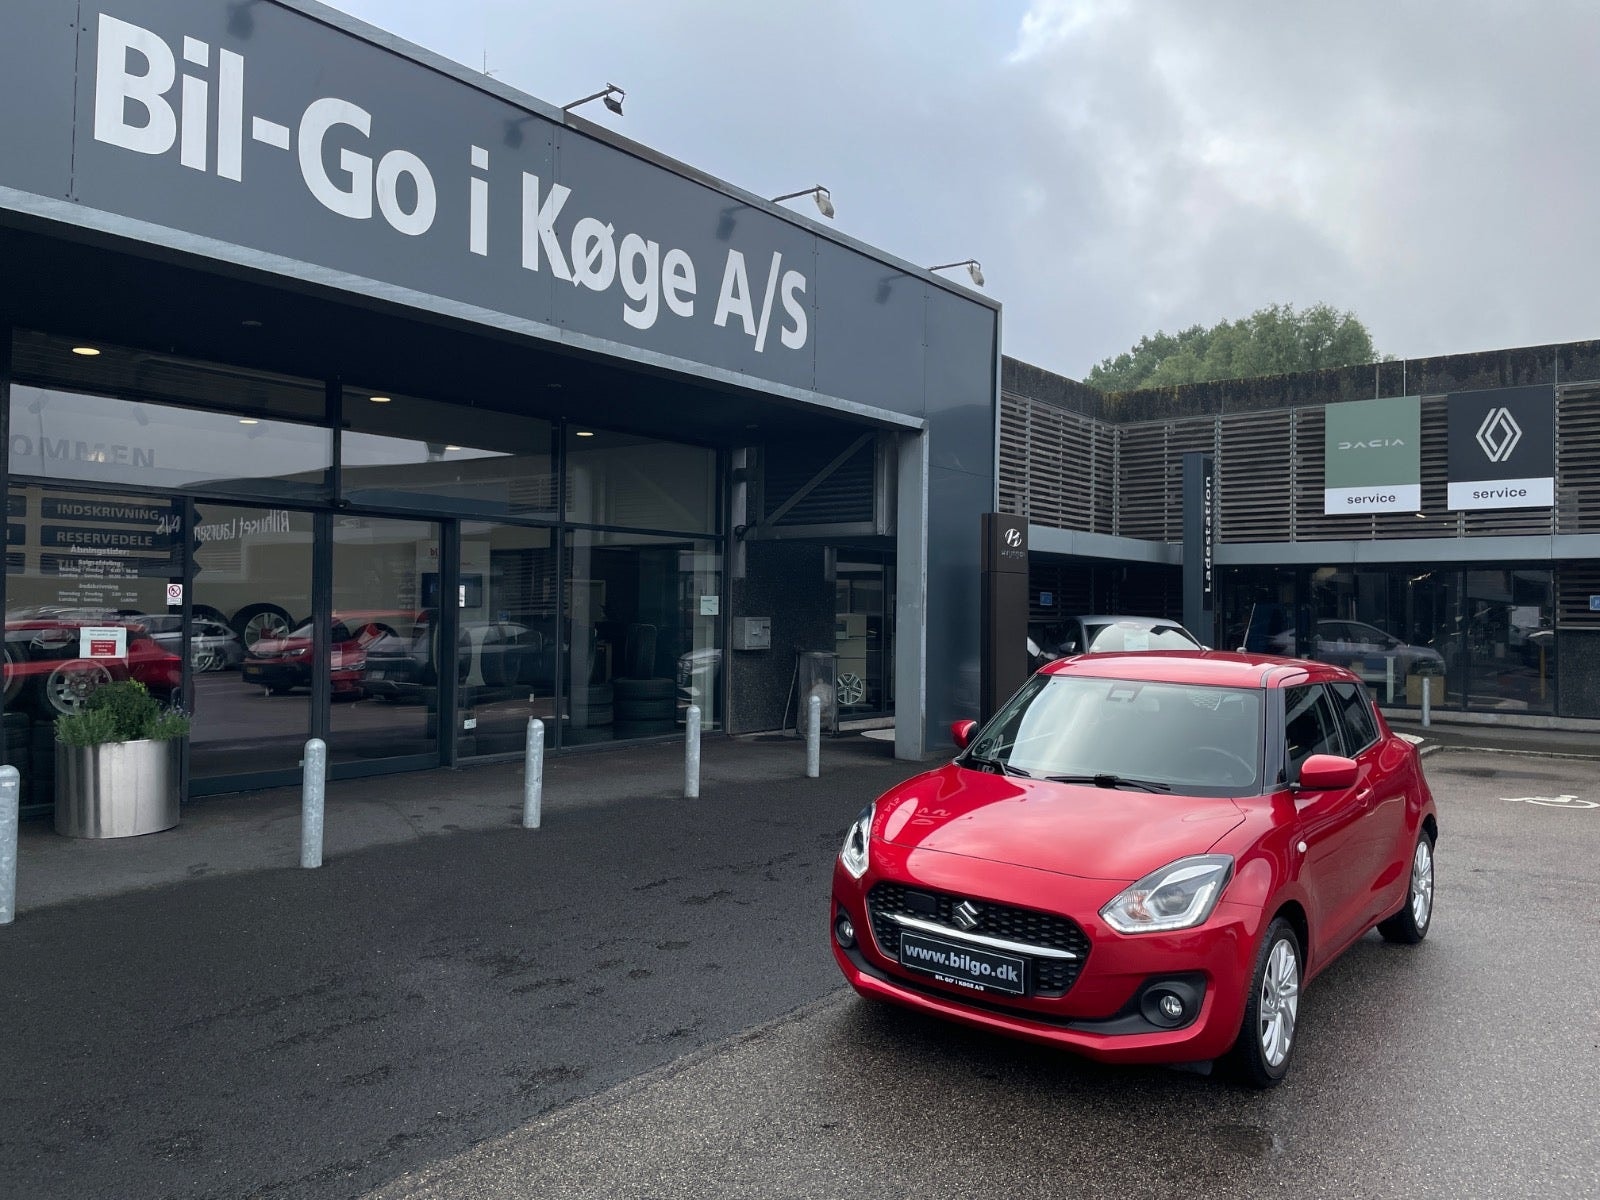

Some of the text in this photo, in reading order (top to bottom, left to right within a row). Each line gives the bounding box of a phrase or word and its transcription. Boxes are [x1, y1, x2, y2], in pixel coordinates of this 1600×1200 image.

[93, 12, 808, 353] Bil-Go i Køge A/S
[1338, 439, 1405, 450] DACIA
[1347, 493, 1396, 504] service
[1473, 487, 1527, 499] service
[57, 503, 159, 520] INDSKRIVNING
[57, 531, 153, 546] RESERVEDELE
[905, 944, 1019, 983] www.bilgo.dk
